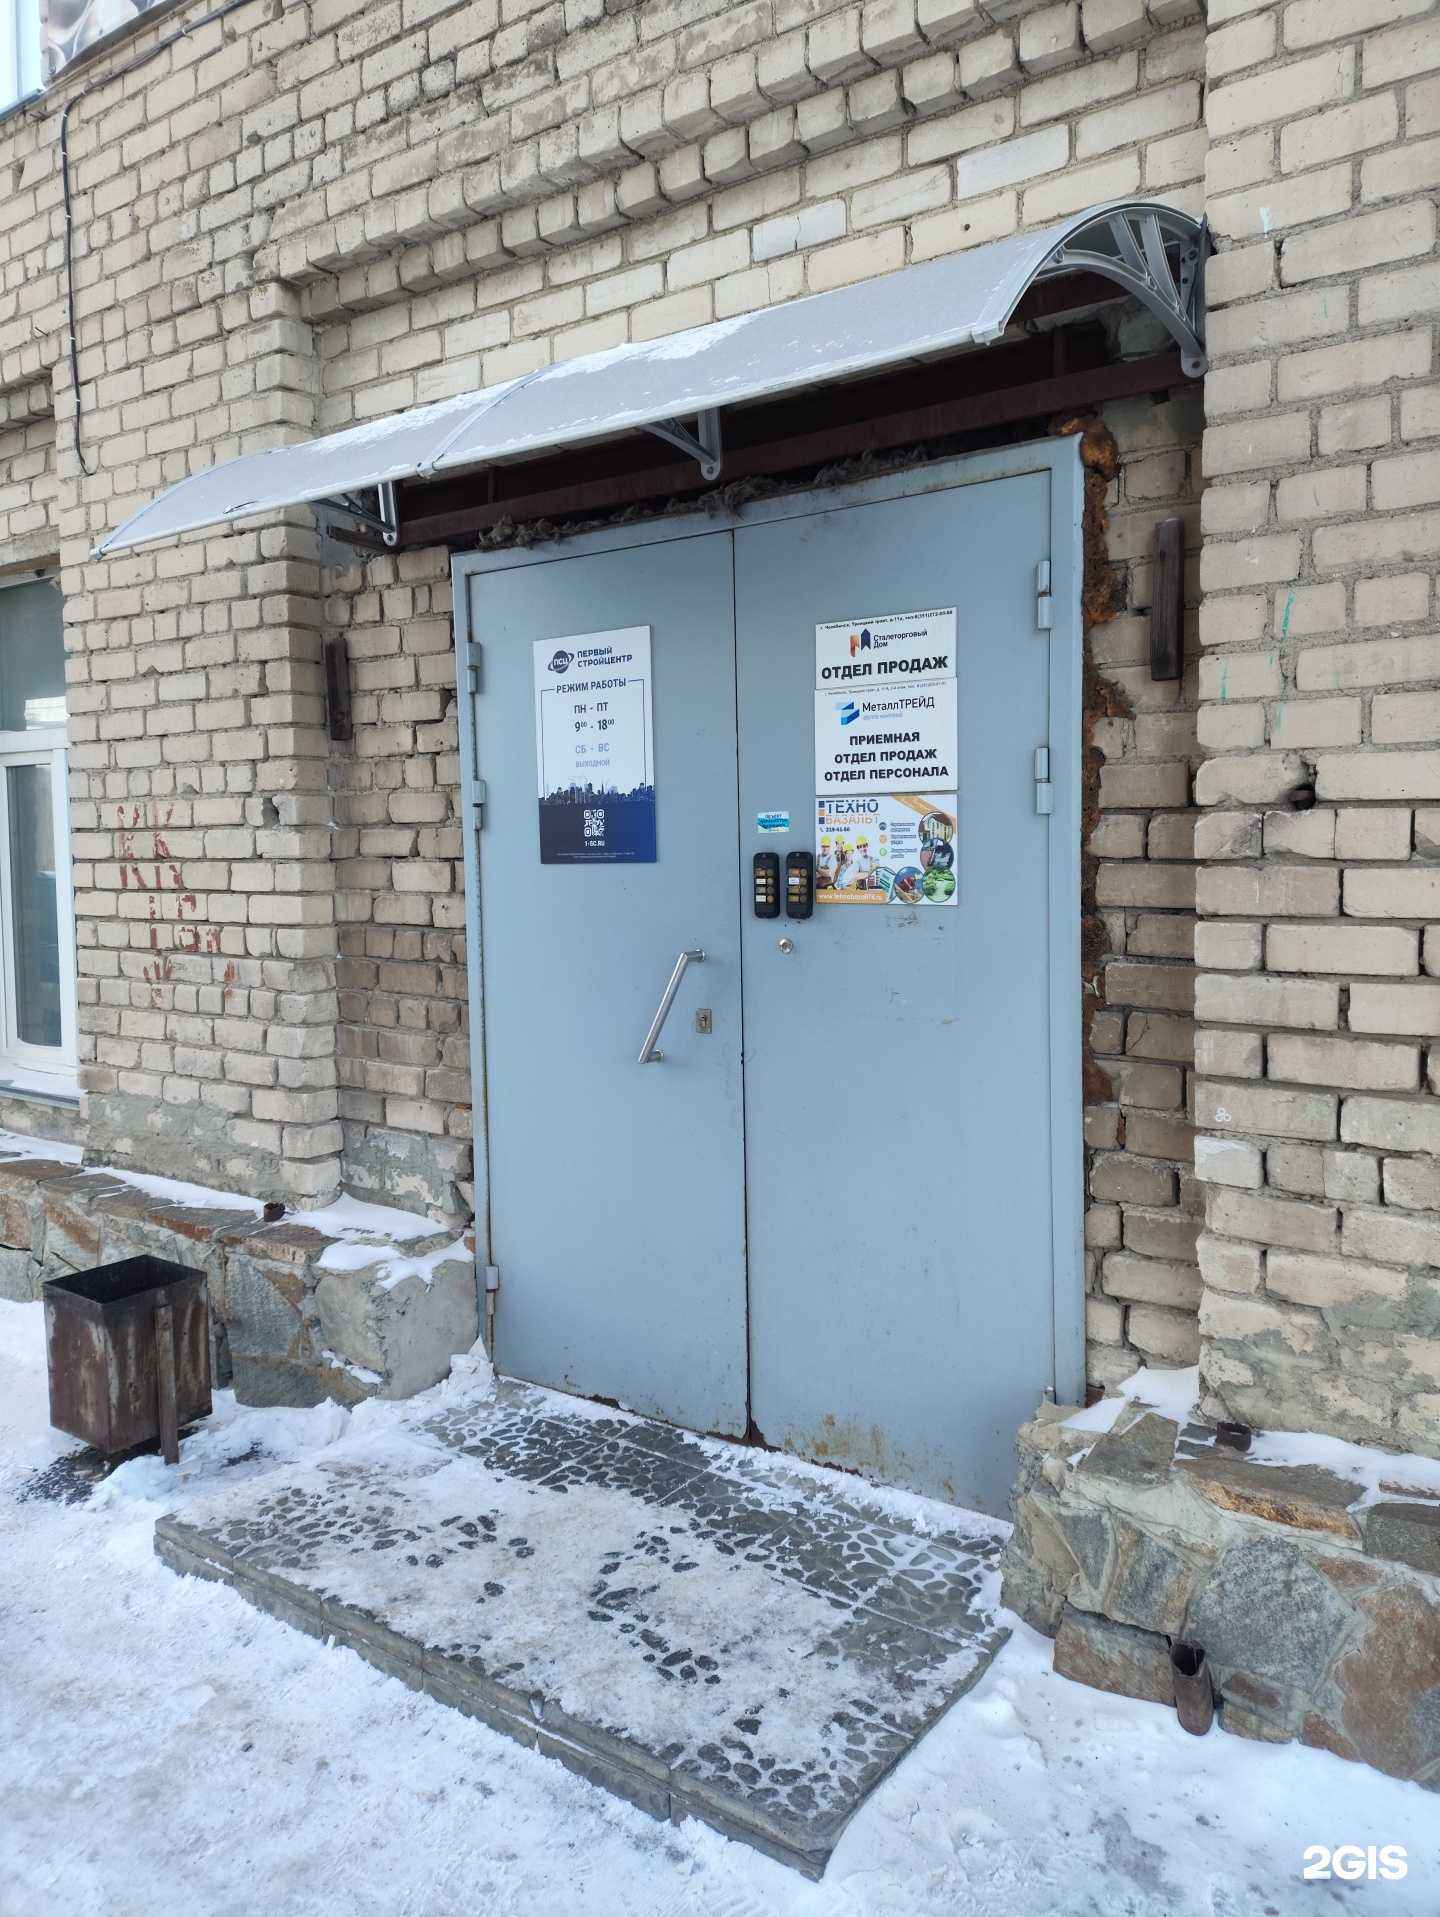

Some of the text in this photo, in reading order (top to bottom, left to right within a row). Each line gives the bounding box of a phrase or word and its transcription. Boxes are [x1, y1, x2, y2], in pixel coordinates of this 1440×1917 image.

[873, 629, 928, 642] Сталеторговый
[577, 645, 613, 658] ПЕРВЫЙ
[873, 641, 888, 649] Дом
[577, 654, 633, 668] СТРОЙЦЕНТР
[821, 656, 948, 680] ОТДЕЛ ПРОДАЖ
[556, 678, 627, 693] РЕЖИМ РАБОТЫ
[574, 704, 587, 714] ПН
[597, 702, 609, 712] ПТ
[862, 695, 935, 712] МеталлТРЕЙД
[849, 731, 921, 746] ПРИЕМНАЯ
[575, 744, 586, 754] СБ
[598, 742, 610, 752] ВС
[575, 758, 610, 768] ВЫХОДНОЙ
[834, 748, 937, 765] ОТДЕЛ ПРОДАЖ
[824, 766, 949, 783] ОТДЕЛ ПЕРСОНАЛА
[825, 799, 879, 813] ТЕХНО
